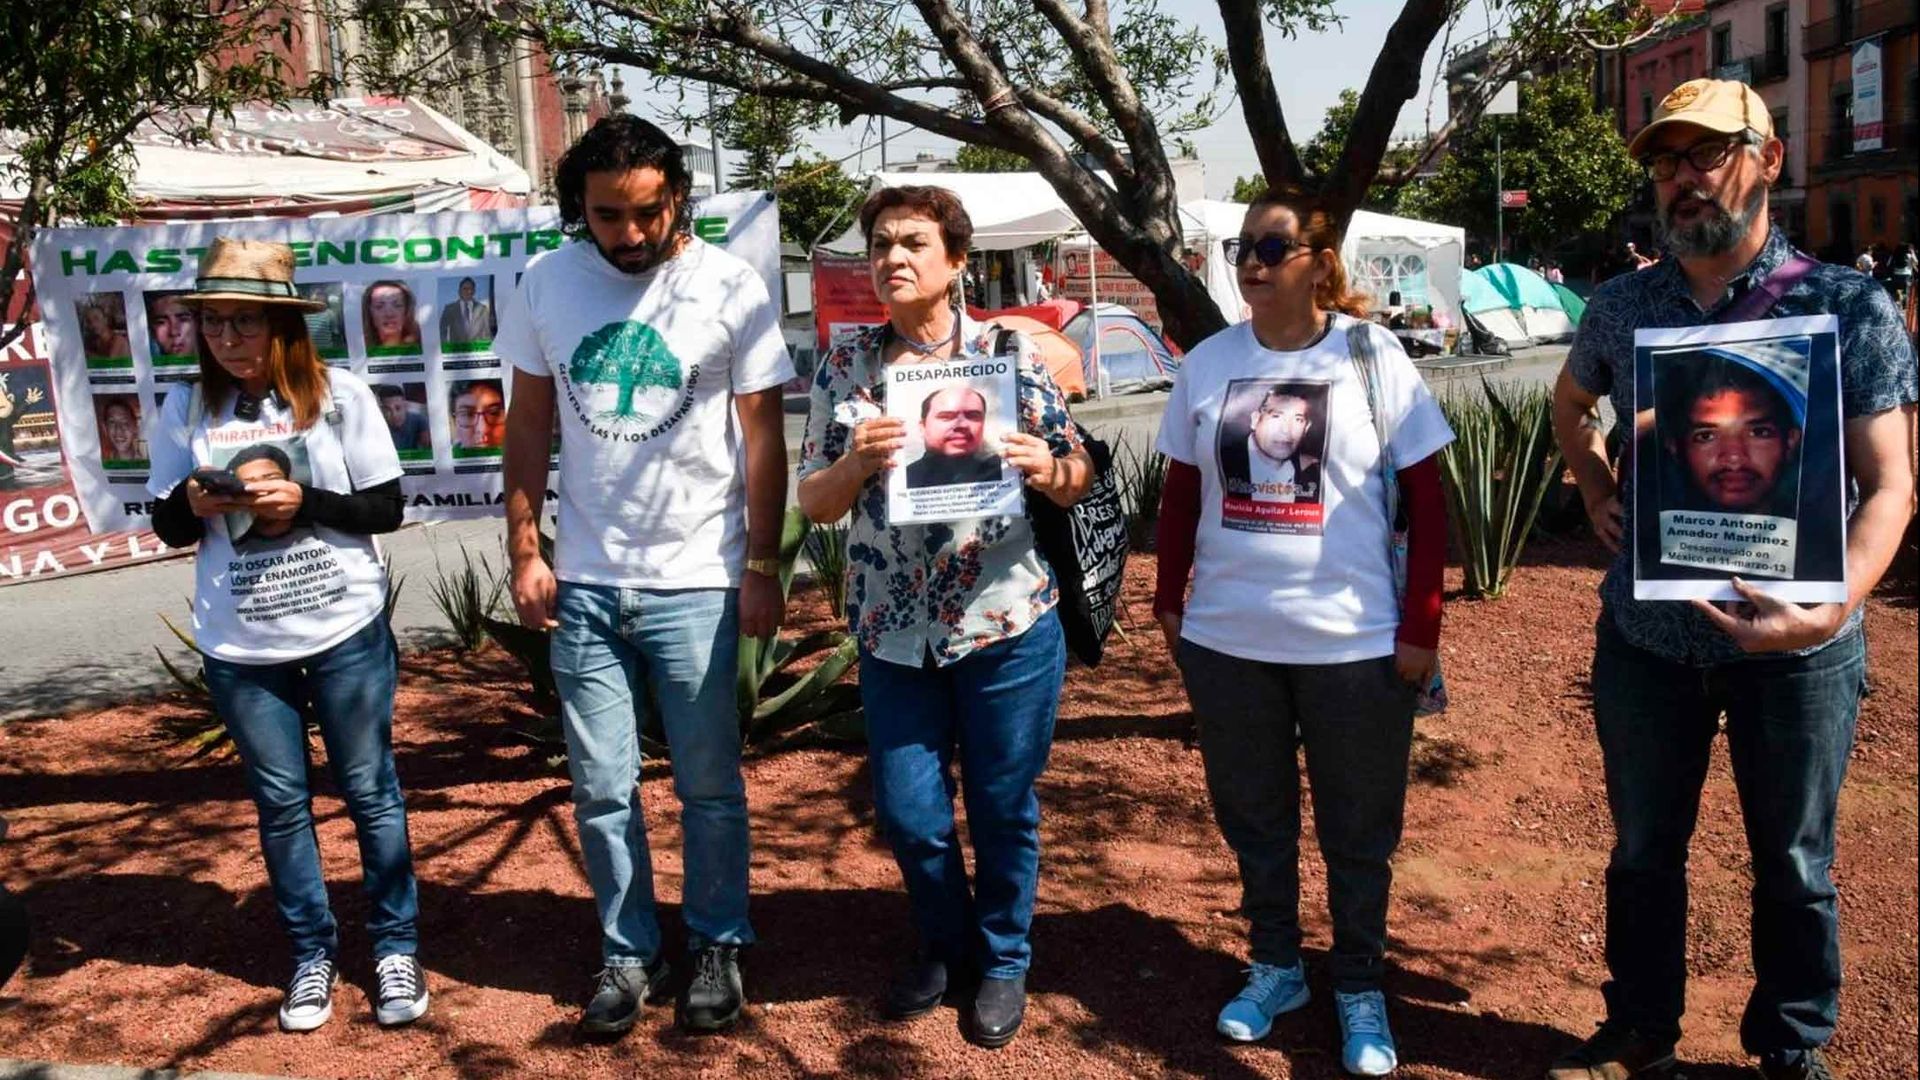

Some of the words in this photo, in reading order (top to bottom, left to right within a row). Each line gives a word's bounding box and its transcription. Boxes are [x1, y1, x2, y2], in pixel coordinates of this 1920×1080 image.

[61, 247, 208, 275] HAST
[895, 362, 1008, 383] DESAPARECIDO
[579, 414, 590, 426] DE
[590, 424, 608, 439] LAS
[612, 433, 620, 442] Y
[624, 433, 648, 443] LOS
[1673, 515, 1715, 526] Marco
[1720, 518, 1777, 531] Antonio
[1667, 527, 1718, 539] Amador
[79, 541, 110, 565] Y
[1680, 542, 1752, 558] Desaparecido
[245, 556, 285, 571] OSCAR
[1707, 556, 1716, 564] el
[265, 558, 338, 582] ENAMORADO
